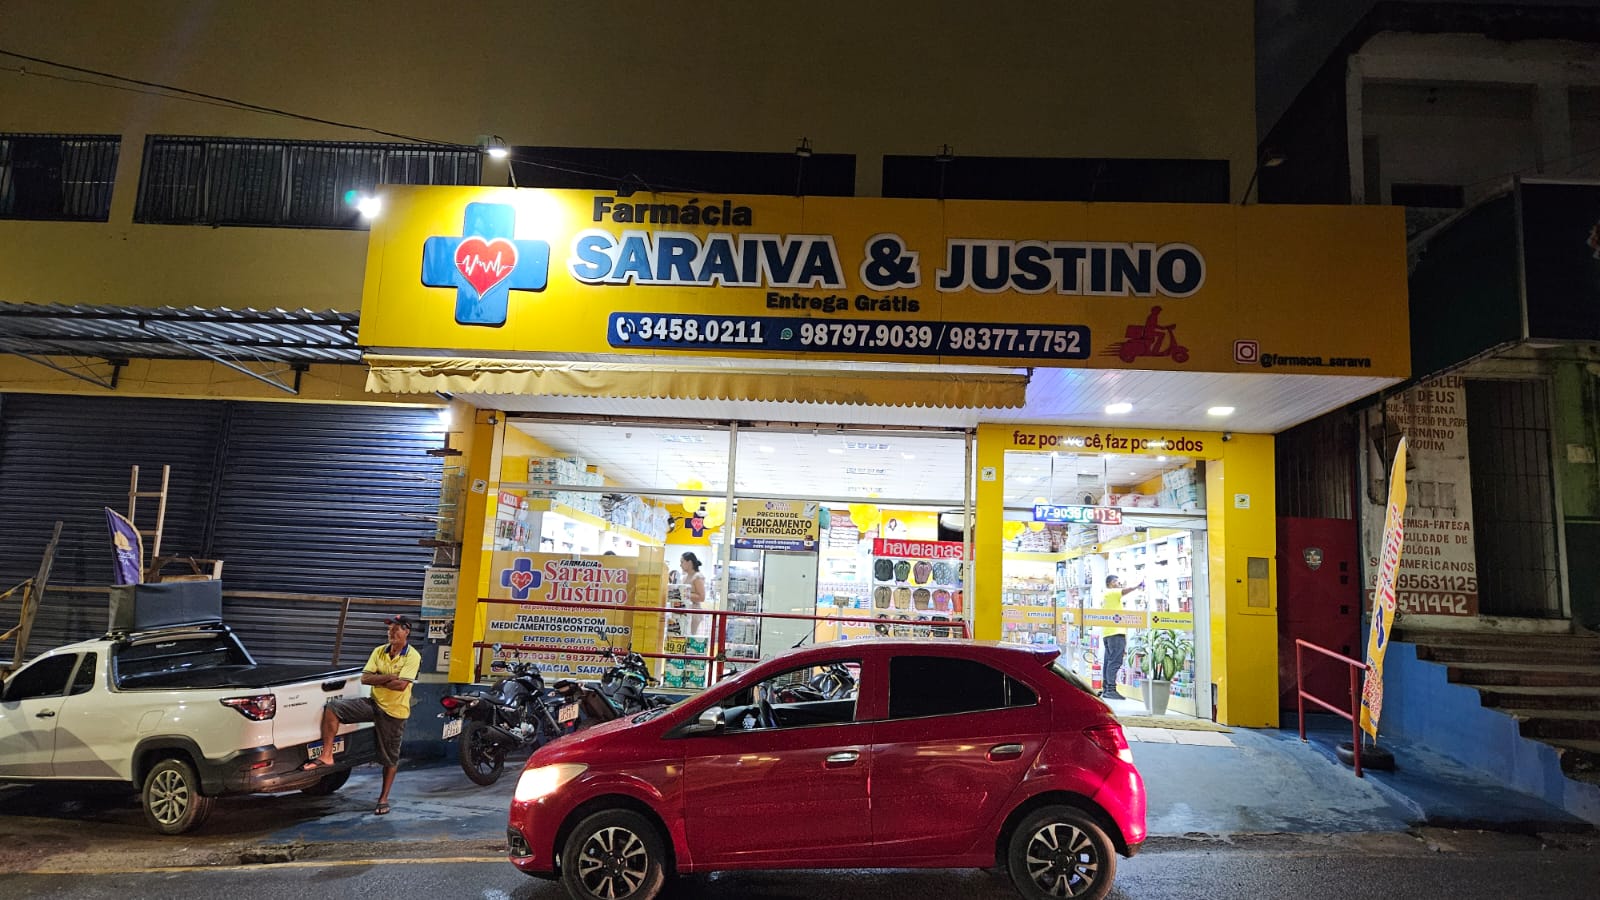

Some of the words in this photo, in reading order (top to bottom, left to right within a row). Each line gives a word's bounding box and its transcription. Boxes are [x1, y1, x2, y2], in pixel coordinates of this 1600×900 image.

[593, 196, 752, 226] Farmácia
[568, 229, 846, 290] SARAIVA
[860, 233, 921, 290] &
[936, 239, 1206, 298] JUSTINO
[766, 293, 849, 314] Entrega
[855, 294, 920, 314] Grátis
[638, 316, 764, 344] 3458.0211
[800, 323, 932, 348] 98797.9039
[949, 326, 1081, 353] 98377.7752
[1418, 391, 1455, 403] DEUS
[1402, 427, 1454, 439] FERNANDO
[1013, 431, 1035, 445] faz
[1106, 434, 1127, 449] faz
[743, 518, 812, 529] MEDICAMENTO
[1402, 519, 1470, 531] EMISA-FATESA
[746, 527, 807, 535] CONTROLADO?
[1403, 533, 1449, 543] CULDADE
[1456, 535, 1468, 544] DE
[883, 539, 963, 559] havaianas
[1402, 546, 1441, 555] EOLOGIA
[560, 559, 598, 567] FARMÁCIA
[544, 561, 628, 583] Saraiva
[1396, 574, 1477, 592] 95631125
[546, 581, 627, 603] Justino
[517, 615, 583, 625] TRABALHAMOS
[491, 622, 561, 632] MEDICAMENTOS
[563, 625, 629, 634] CONTROLADOS
[523, 635, 562, 643] ENTREGA
